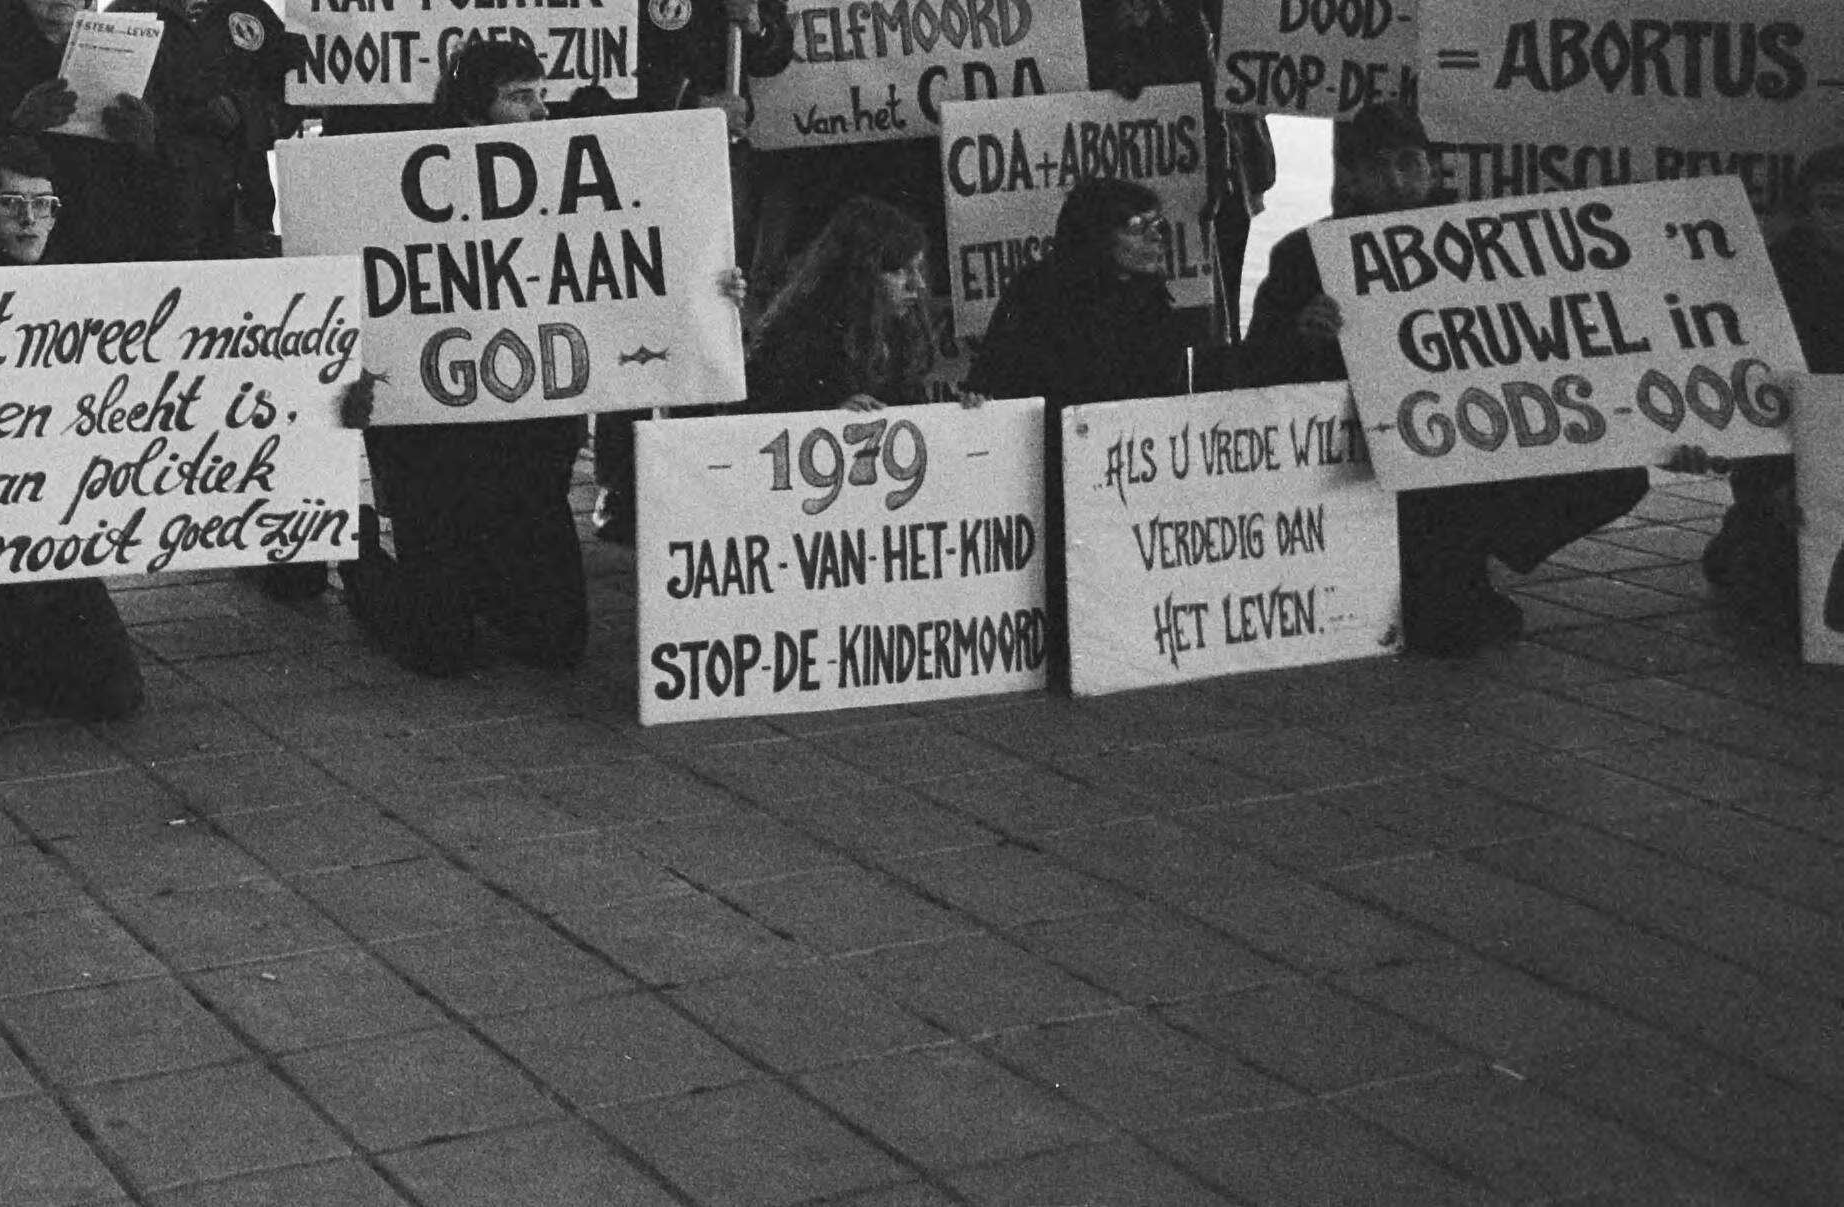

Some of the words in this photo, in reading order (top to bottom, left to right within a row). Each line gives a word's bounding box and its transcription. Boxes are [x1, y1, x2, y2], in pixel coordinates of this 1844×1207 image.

[1493, 18, 1808, 101] ABORTUS
[400, 134, 642, 224] C.D.A.
[1350, 202, 1633, 296] ABORTUS
[14, 286, 182, 369] moreel
[180, 293, 360, 385] misdadig
[419, 321, 591, 407] GOD
[1397, 291, 1653, 374] GRUWEL
[1663, 292, 1750, 350] in
[59, 369, 206, 438] slecht
[59, 430, 281, 526] politiek
[759, 418, 928, 515] 1979
[1169, 421, 1190, 480] U
[1200, 419, 1281, 477] VREDE
[147, 498, 271, 574] goed
[1131, 512, 1264, 572] VERDEDIG
[1276, 503, 1326, 557] DAN
[1154, 591, 1210, 671] HET
